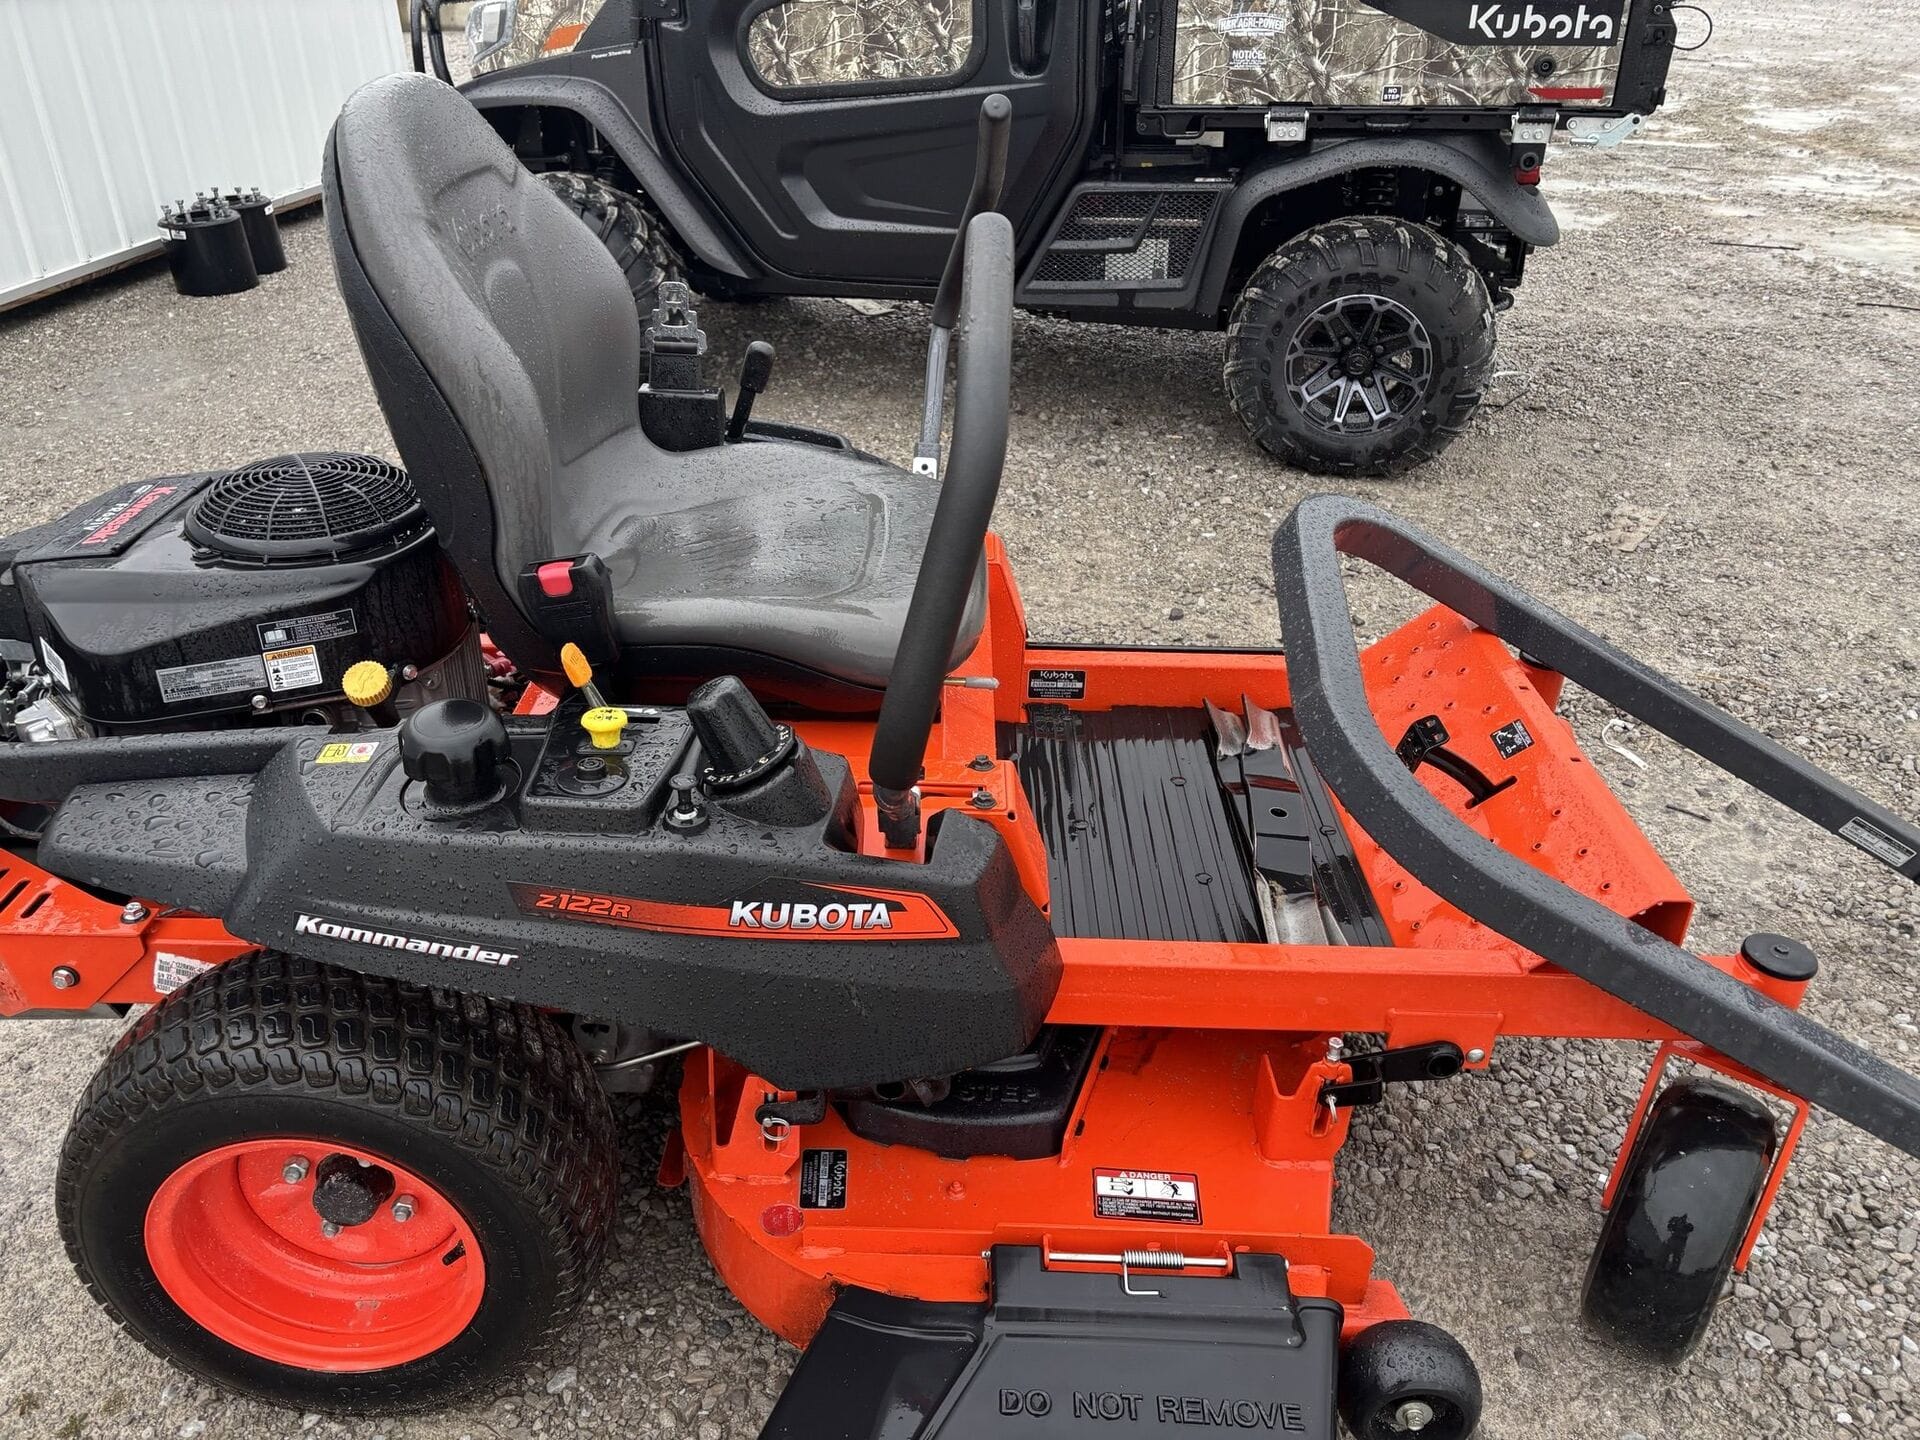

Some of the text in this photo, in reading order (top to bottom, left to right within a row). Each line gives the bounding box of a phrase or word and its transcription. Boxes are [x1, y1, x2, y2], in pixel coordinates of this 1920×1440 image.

[1469, 5, 1614, 39] Kubota
[608, 49, 632, 57] Steering
[1232, 49, 1264, 60] NOTICE
[82, 486, 178, 544] Kawasaki
[276, 648, 309, 659] WARNING
[1040, 671, 1074, 679] Kubota
[535, 893, 631, 918] Z122R
[729, 901, 892, 930] KUBOTA
[295, 914, 519, 966] Kommander
[959, 1086, 1037, 1103] STEP
[833, 1161, 845, 1197] Kubota
[1129, 1171, 1171, 1181] DANGER
[999, 1388, 1306, 1431] DO NOT REMOVE
